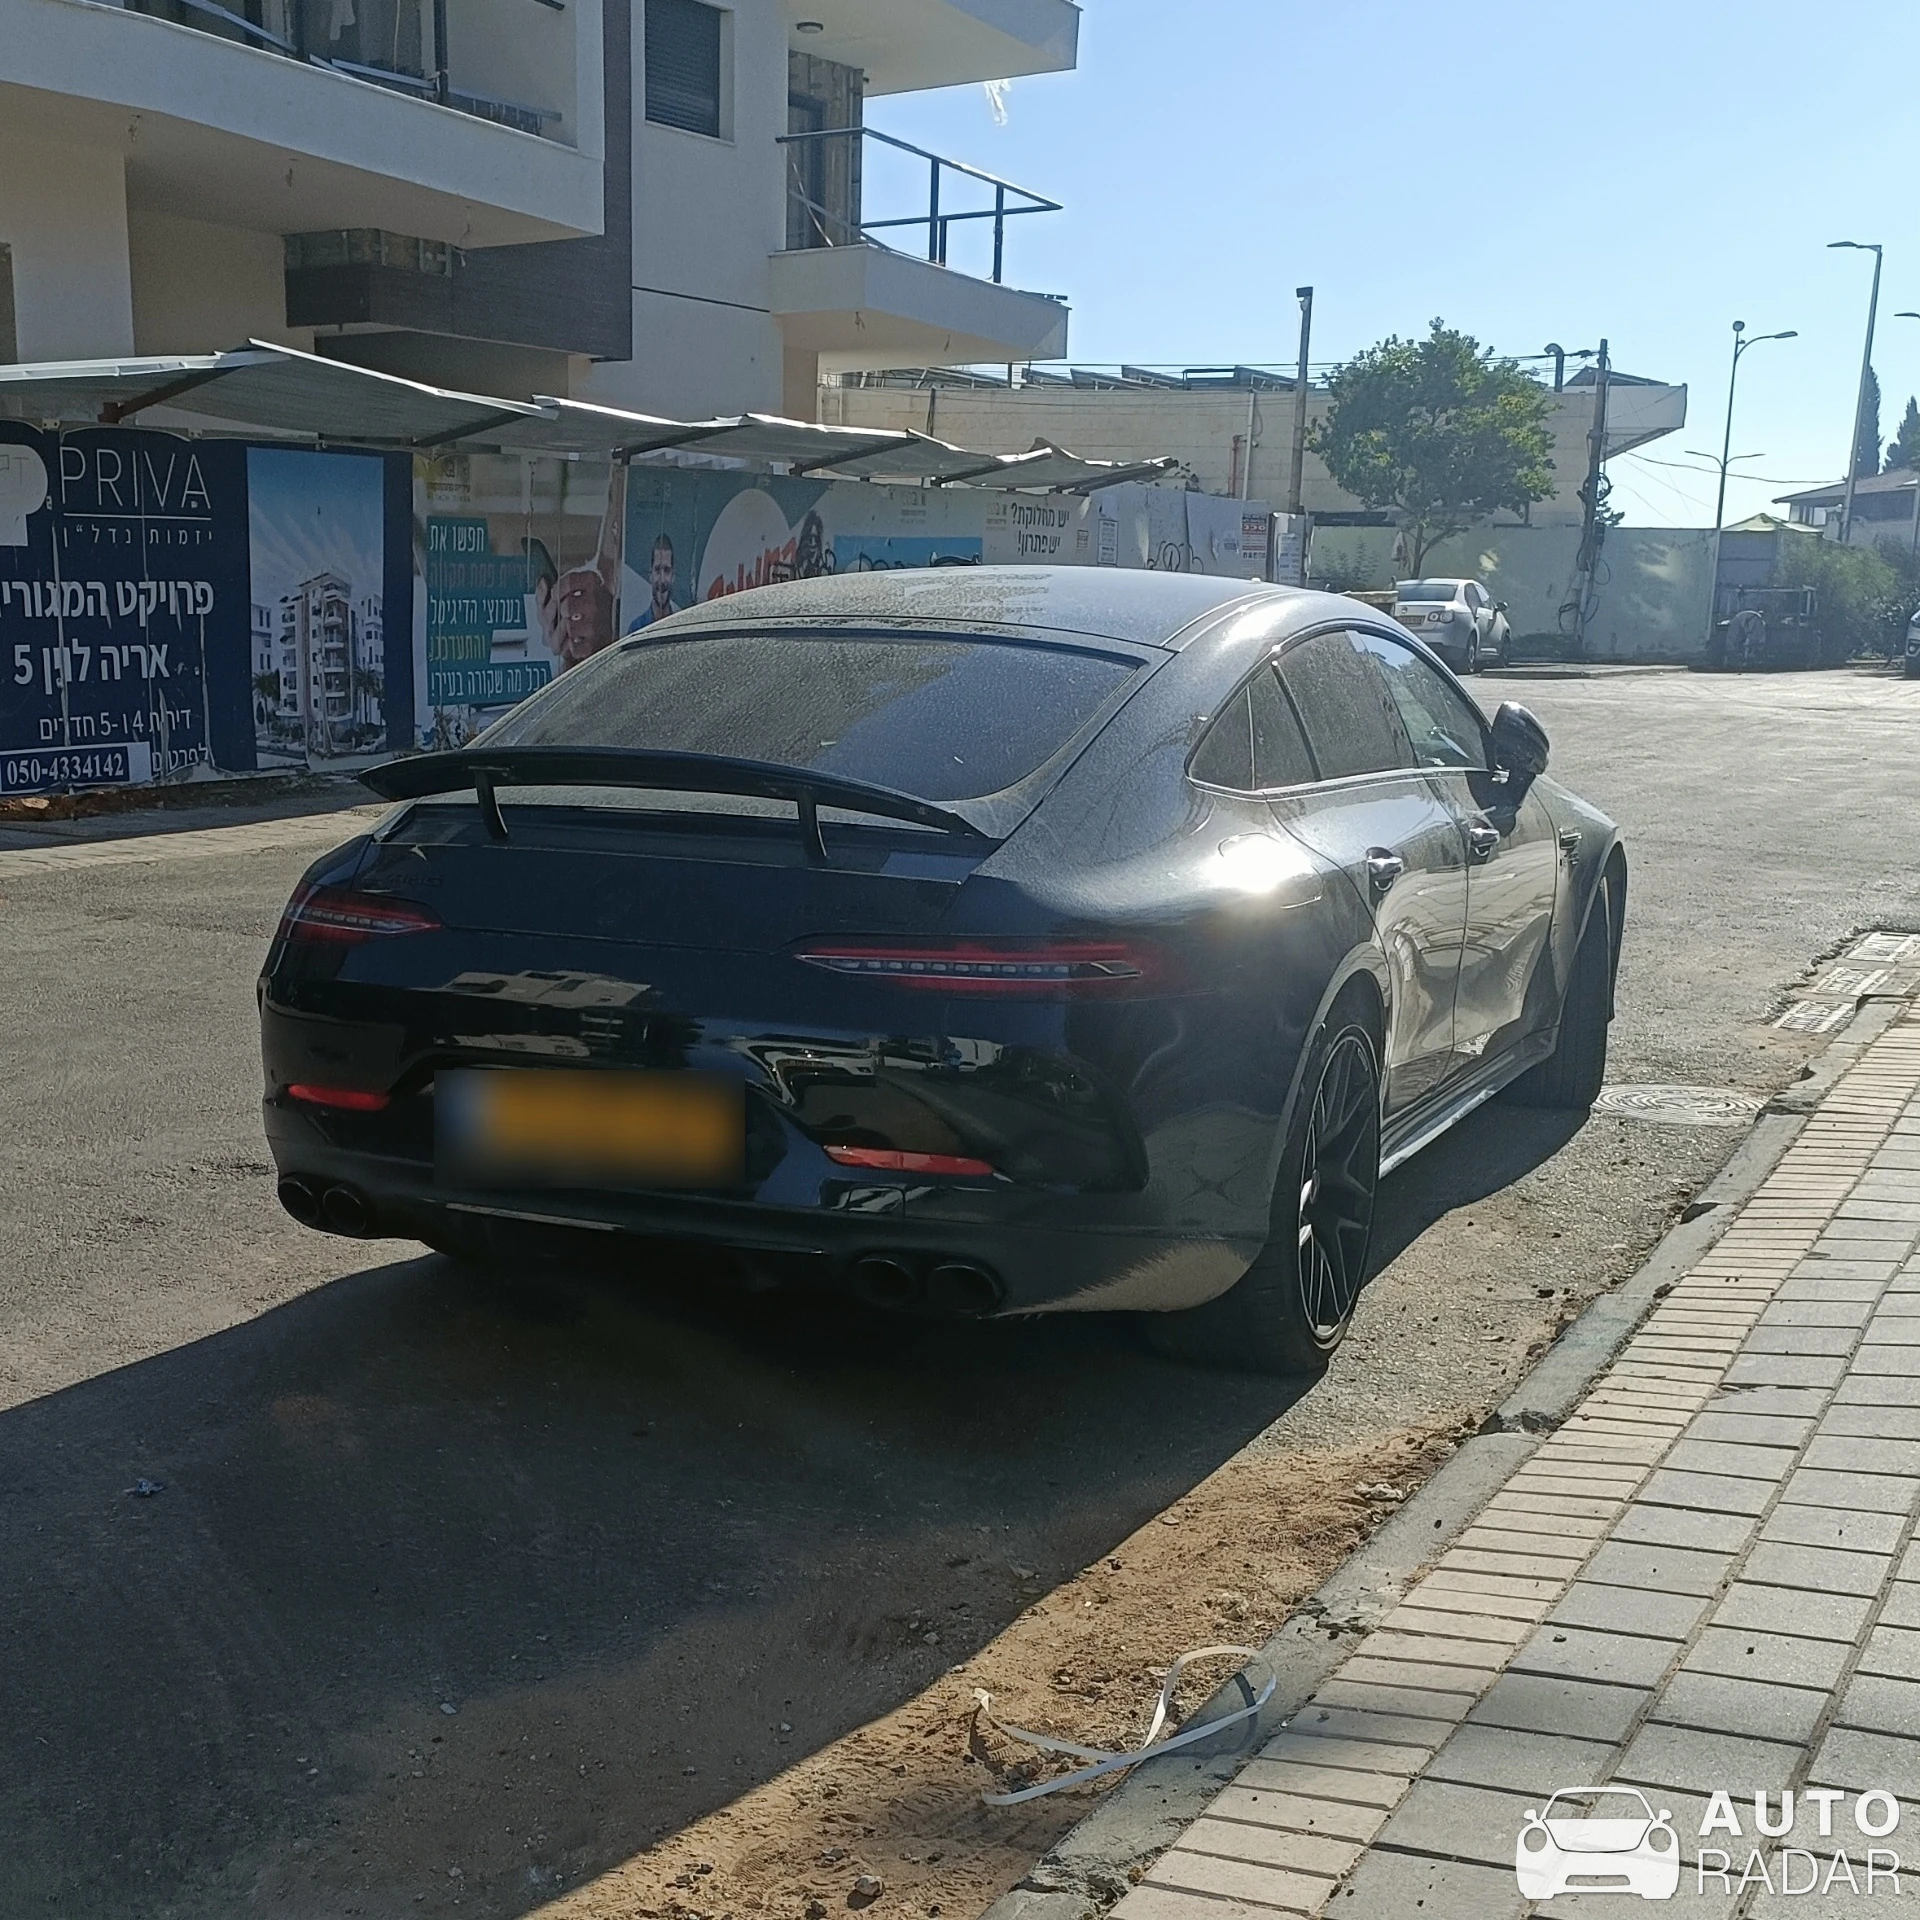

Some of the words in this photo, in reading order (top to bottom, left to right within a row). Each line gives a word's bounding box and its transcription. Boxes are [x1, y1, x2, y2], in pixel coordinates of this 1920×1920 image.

[60, 446, 212, 509] PRIVA
[1011, 502, 1055, 529] מחלוקת?
[1058, 510, 1070, 527] יש
[63, 524, 132, 547] נדל"ן
[149, 530, 212, 545] יזמות
[429, 525, 447, 551] את
[452, 525, 485, 552] חפשו
[1018, 531, 1048, 557] פתרון!
[1049, 536, 1061, 554] יש
[0, 581, 107, 618] המגורי
[116, 581, 214, 627] פרויקט
[429, 595, 477, 625] הדיגיטל
[482, 598, 521, 624] בערוצי
[14, 645, 33, 685] 5
[43, 638, 91, 695] לוין
[100, 644, 170, 681] אריה
[431, 671, 464, 697] בעיר!
[467, 670, 503, 698] שקורה
[507, 668, 521, 693] מה
[132, 710, 144, 734] 4
[149, 708, 191, 733] דירת
[7, 753, 124, 785] 050-4334142
[152, 742, 208, 772] לפרטם
